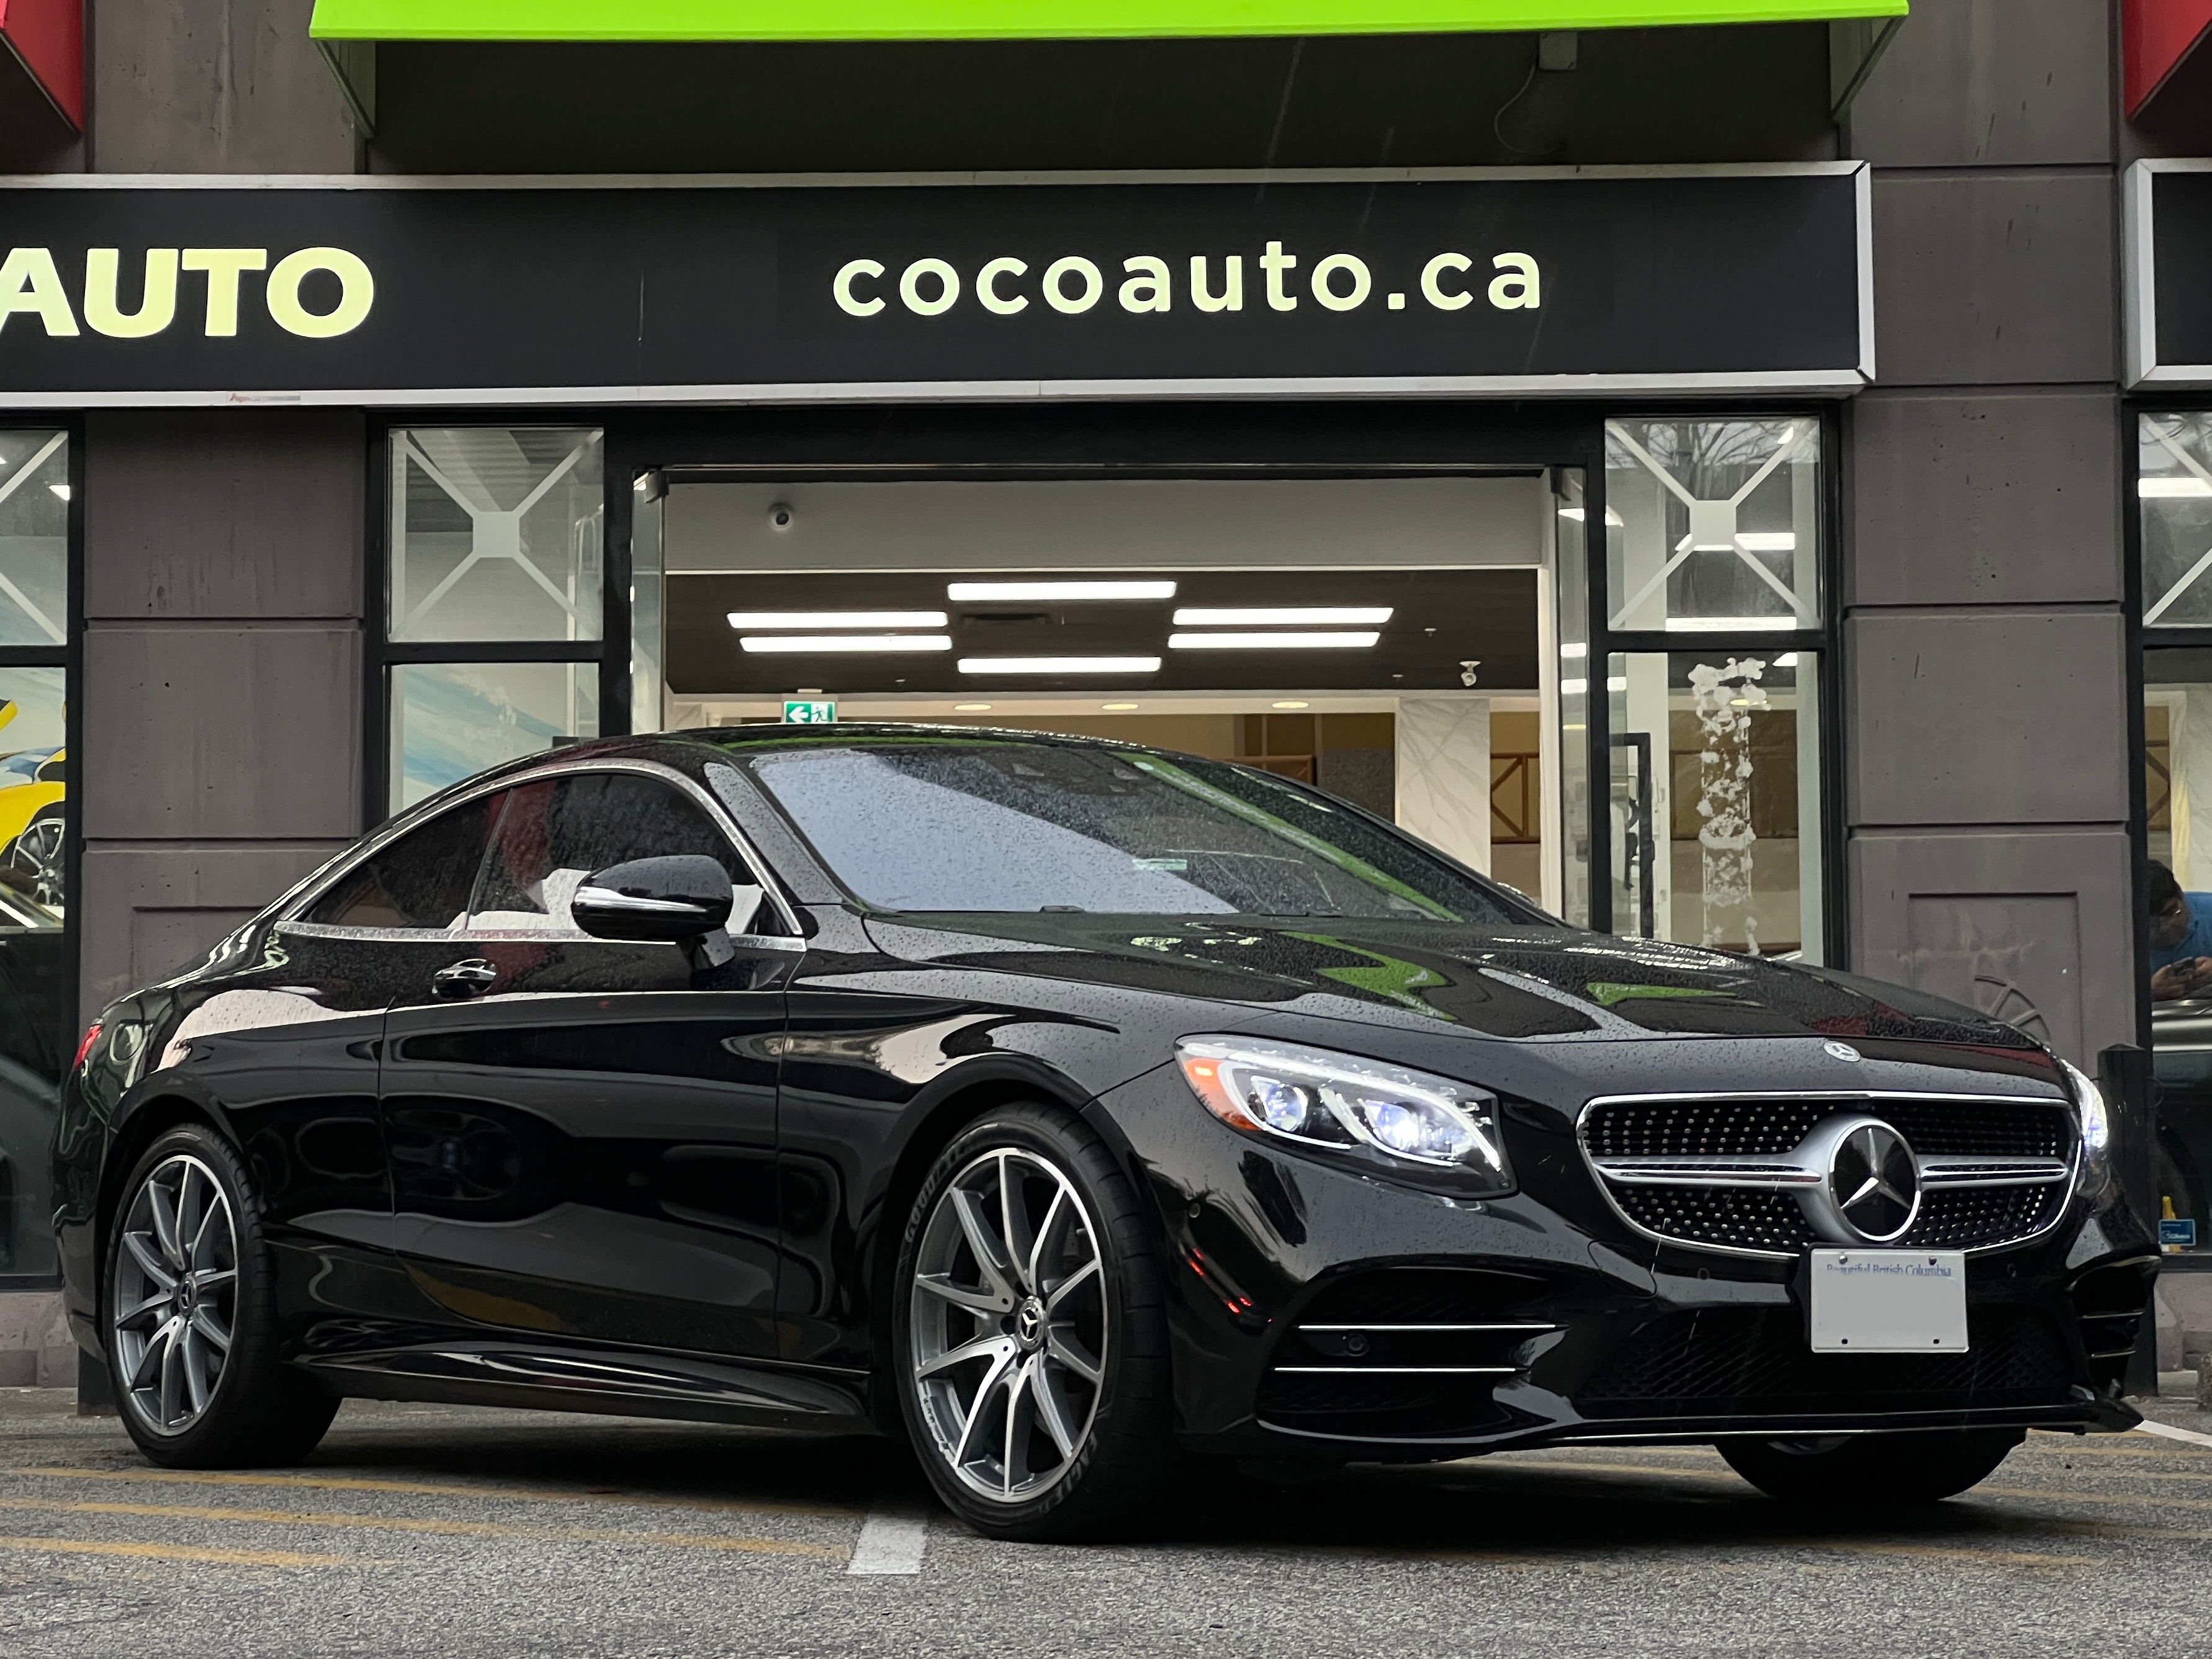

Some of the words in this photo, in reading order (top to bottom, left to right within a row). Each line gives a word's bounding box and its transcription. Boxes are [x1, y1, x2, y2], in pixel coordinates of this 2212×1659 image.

[0, 247, 374, 338] AUTO
[833, 241, 1540, 316] cocoauto.ca
[1905, 1263, 1951, 1276] Columbia
